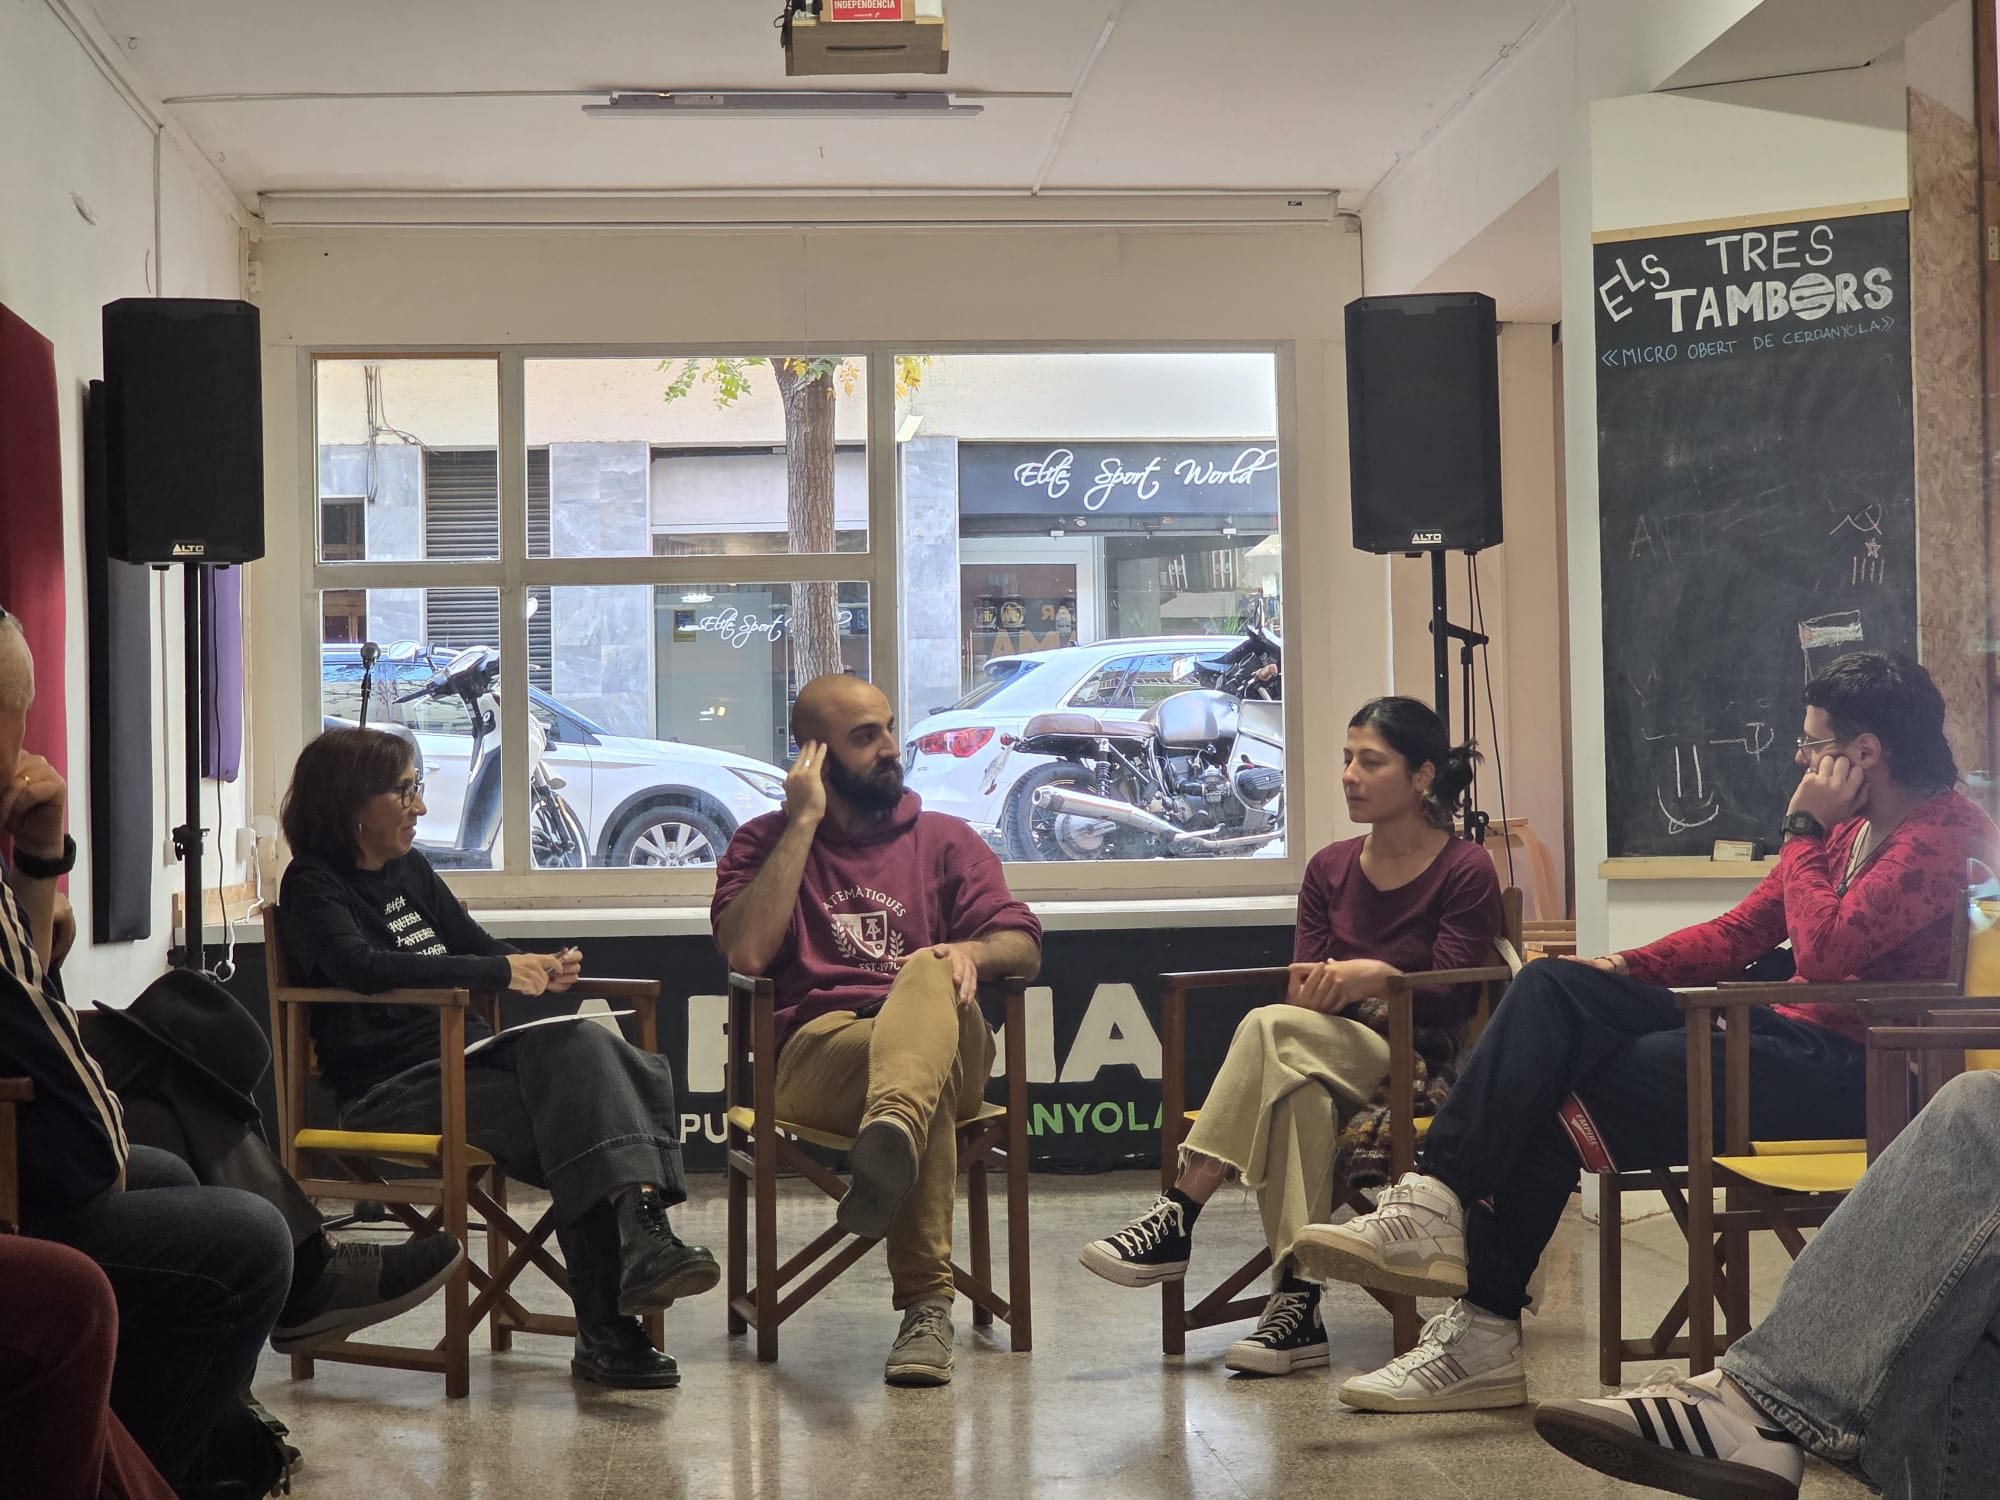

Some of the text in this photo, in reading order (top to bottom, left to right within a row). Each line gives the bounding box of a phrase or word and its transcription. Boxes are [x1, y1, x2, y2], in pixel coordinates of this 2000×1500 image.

[1599, 224, 1834, 322] ELS TRES
[1654, 267, 1893, 333] TAMBORS
[1687, 340, 1738, 361] OBERT
[1752, 333, 1775, 350] DE
[1014, 447, 1277, 511] Elite Sport World
[172, 543, 205, 553] ALTO
[1411, 533, 1442, 542] ALTO
[699, 607, 739, 640] Elite
[731, 614, 784, 648] Sport
[823, 885, 907, 918] ATEMÀTIQUES
